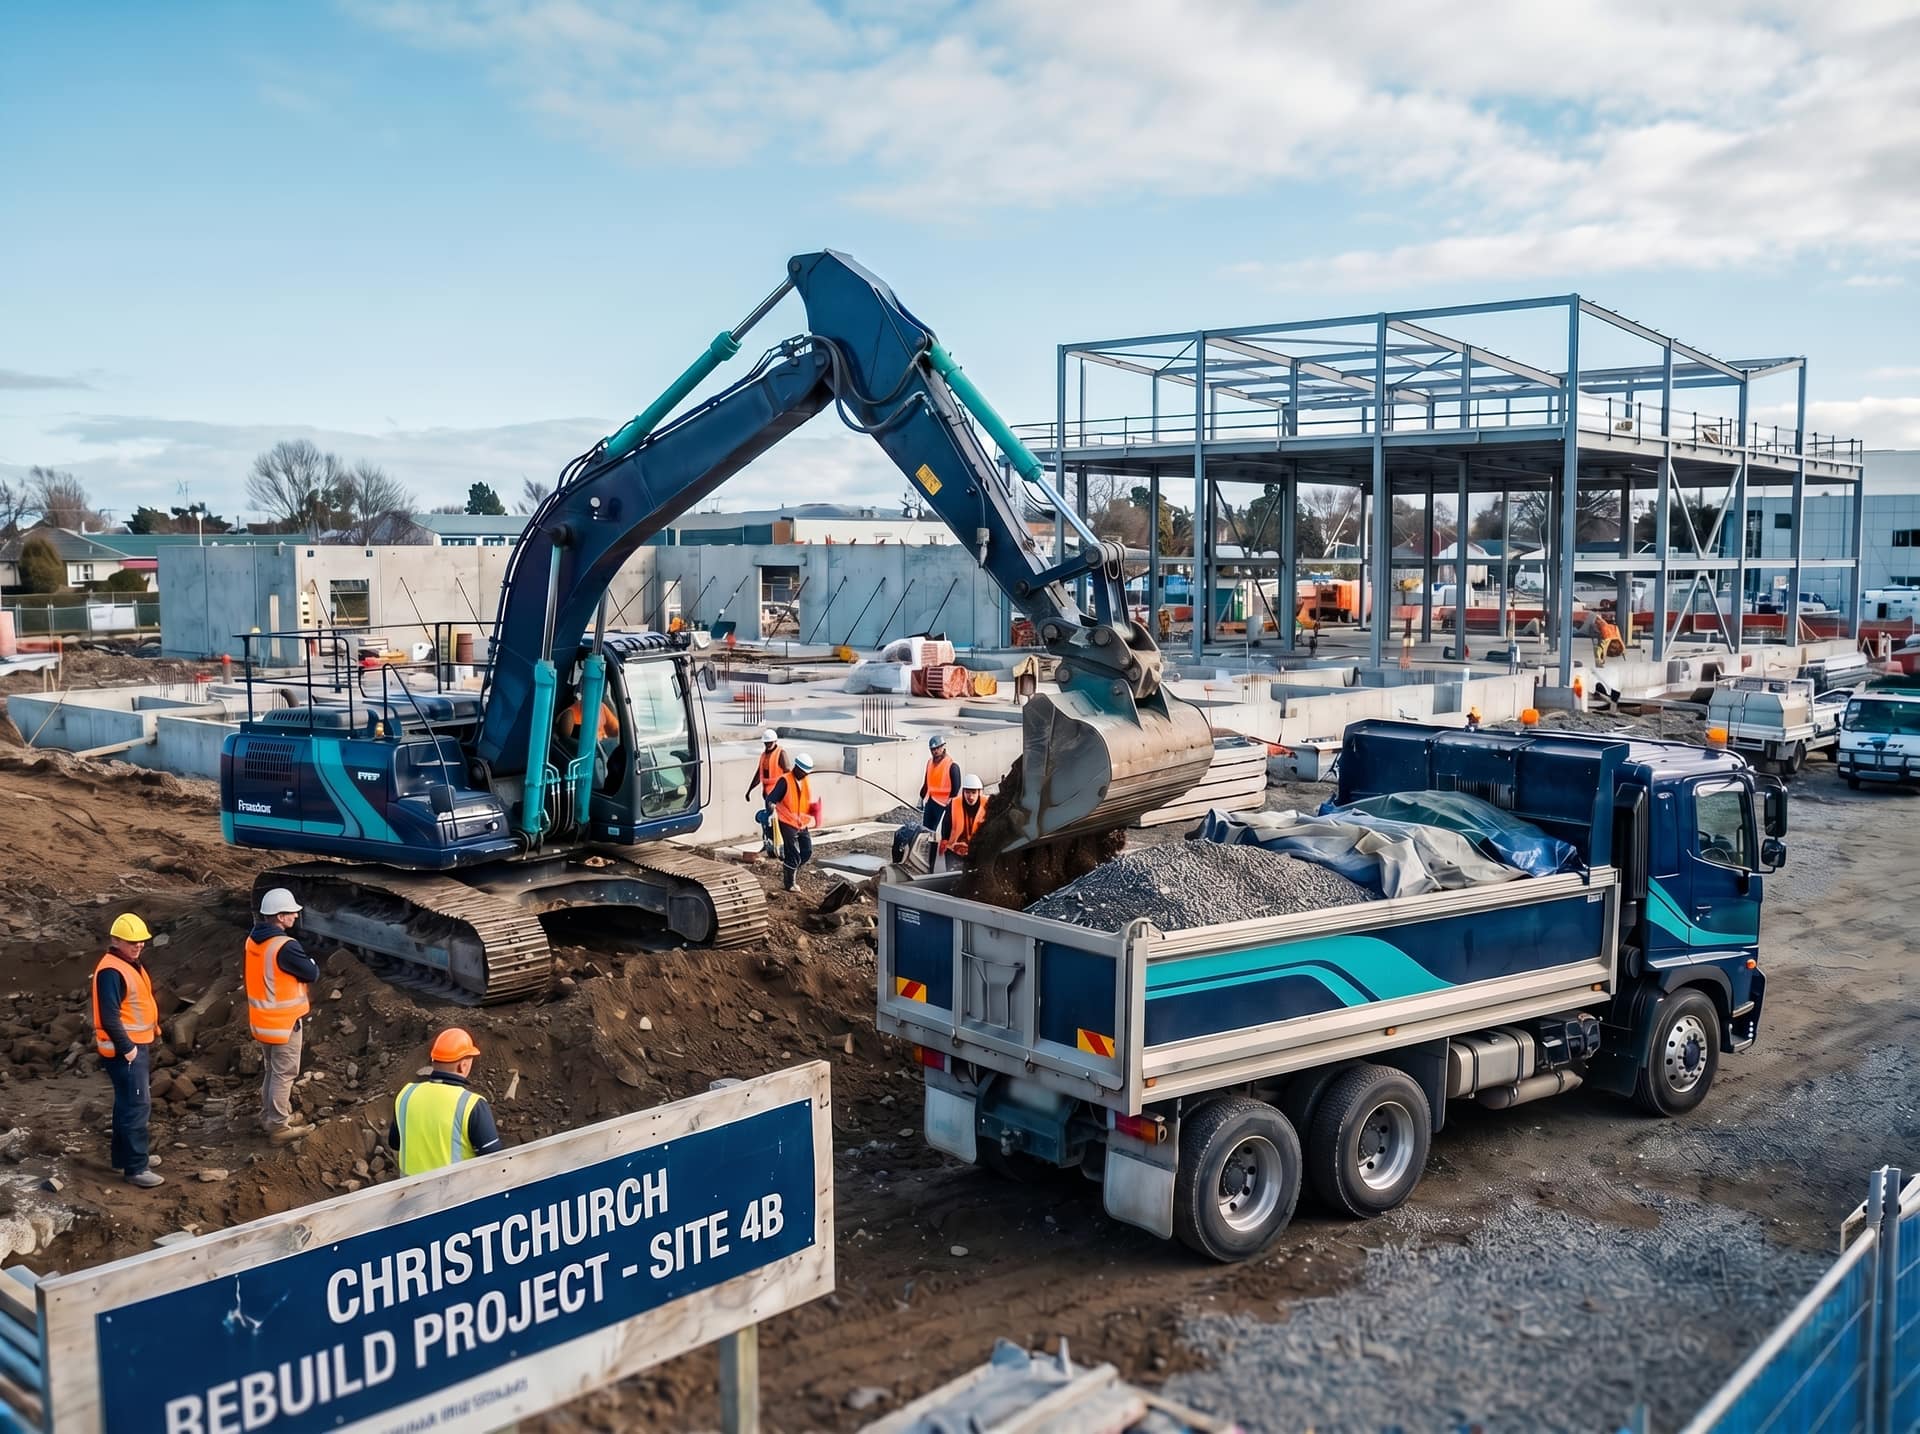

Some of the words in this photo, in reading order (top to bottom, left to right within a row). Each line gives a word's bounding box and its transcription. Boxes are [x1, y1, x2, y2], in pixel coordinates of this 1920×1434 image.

[165, 1330, 397, 1434] REBUILD
[414, 1252, 610, 1369] PROJECT
[622, 1264, 638, 1278] -
[649, 1210, 730, 1280] SITE
[740, 1192, 784, 1242] 4B
[327, 1168, 669, 1324] CHRISTCHURCH
